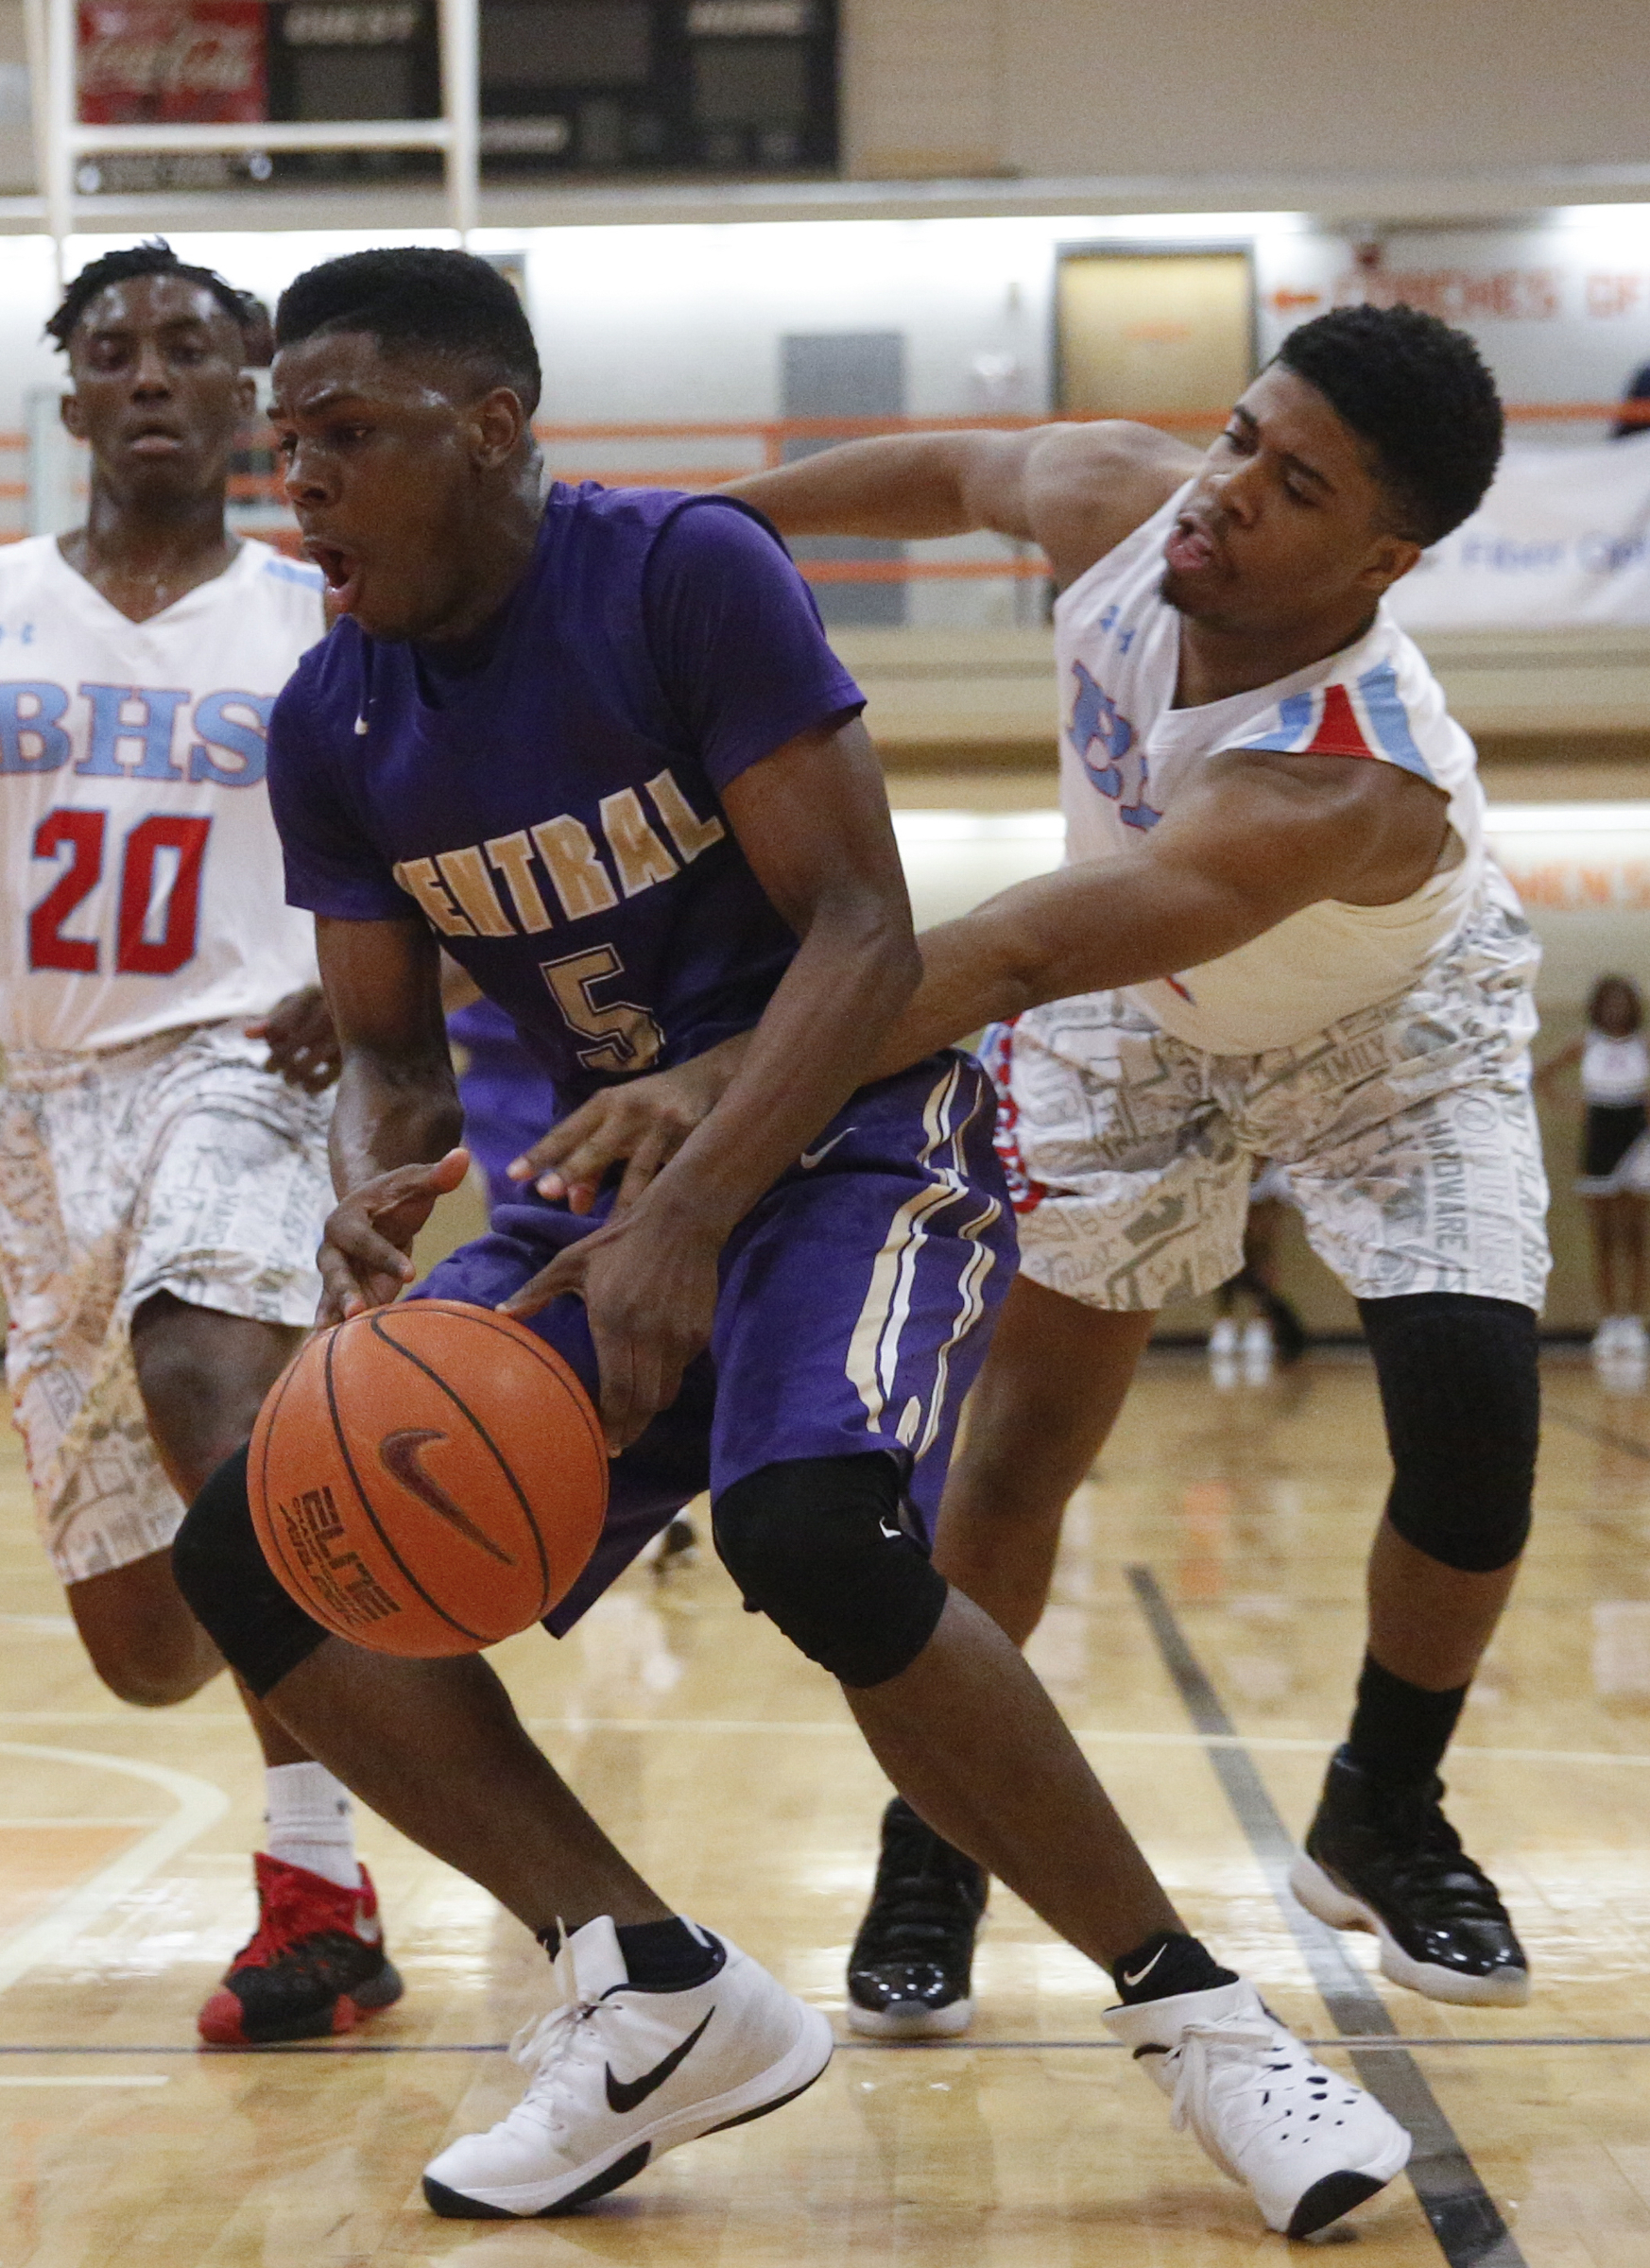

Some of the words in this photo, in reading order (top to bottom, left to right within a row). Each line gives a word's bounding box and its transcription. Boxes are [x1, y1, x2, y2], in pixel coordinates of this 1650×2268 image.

[0, 679, 281, 788] BHS
[28, 806, 215, 976] 20
[539, 943, 666, 1072] 5
[301, 1486, 402, 1620] ELITE
